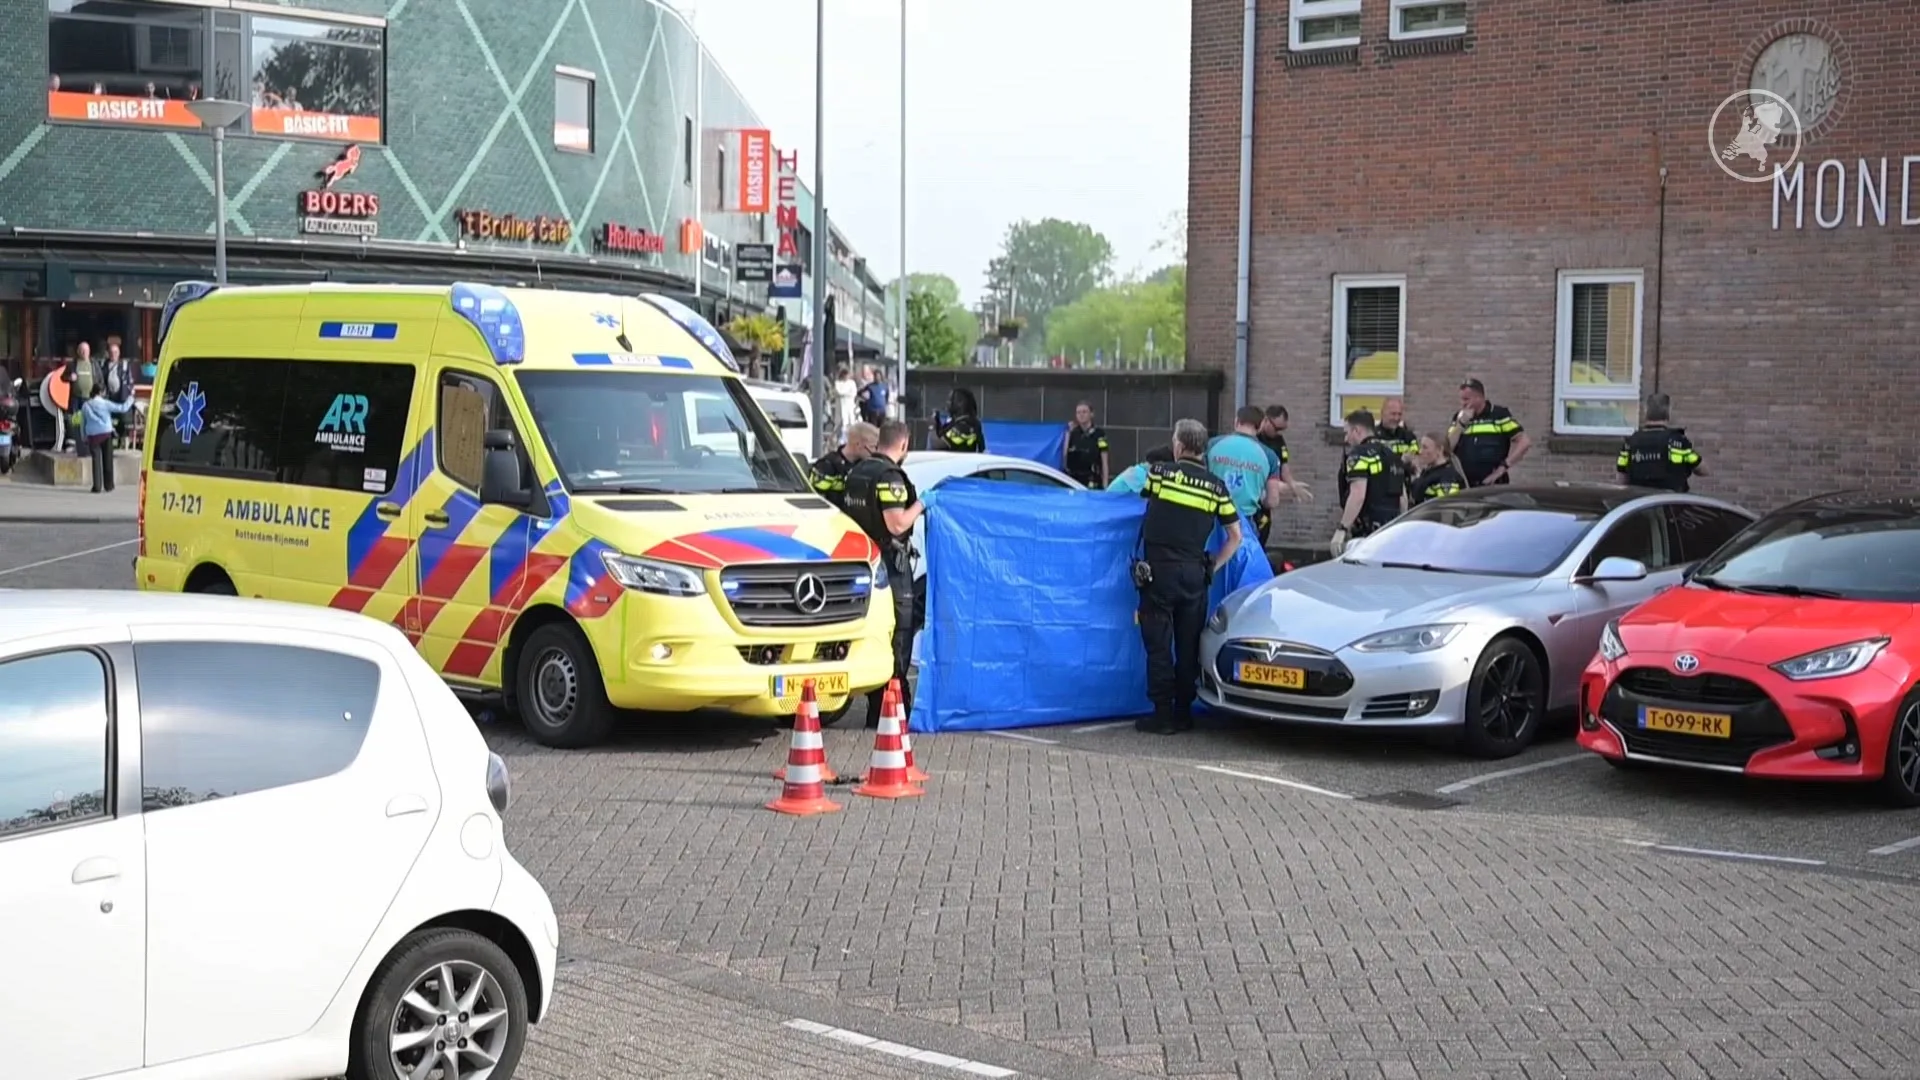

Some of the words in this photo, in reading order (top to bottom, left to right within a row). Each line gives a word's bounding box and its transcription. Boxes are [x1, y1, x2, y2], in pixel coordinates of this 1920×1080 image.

[87, 100, 165, 119] BASIC-FIT
[284, 115, 348, 134] BASIC-FIT
[747, 135, 764, 206] BASIC-FIT
[307, 191, 378, 216] BOERS
[608, 221, 665, 253] Heineken
[318, 394, 369, 434] ARR
[315, 431, 366, 447] AMBULANCE
[162, 492, 202, 515] 17-121
[223, 498, 331, 530] AMBULANCE
[235, 528, 310, 548] Rotterdam-Rijnmond
[1243, 664, 1298, 686] 5-SVF-53
[1650, 710, 1724, 735] T-099-RK
